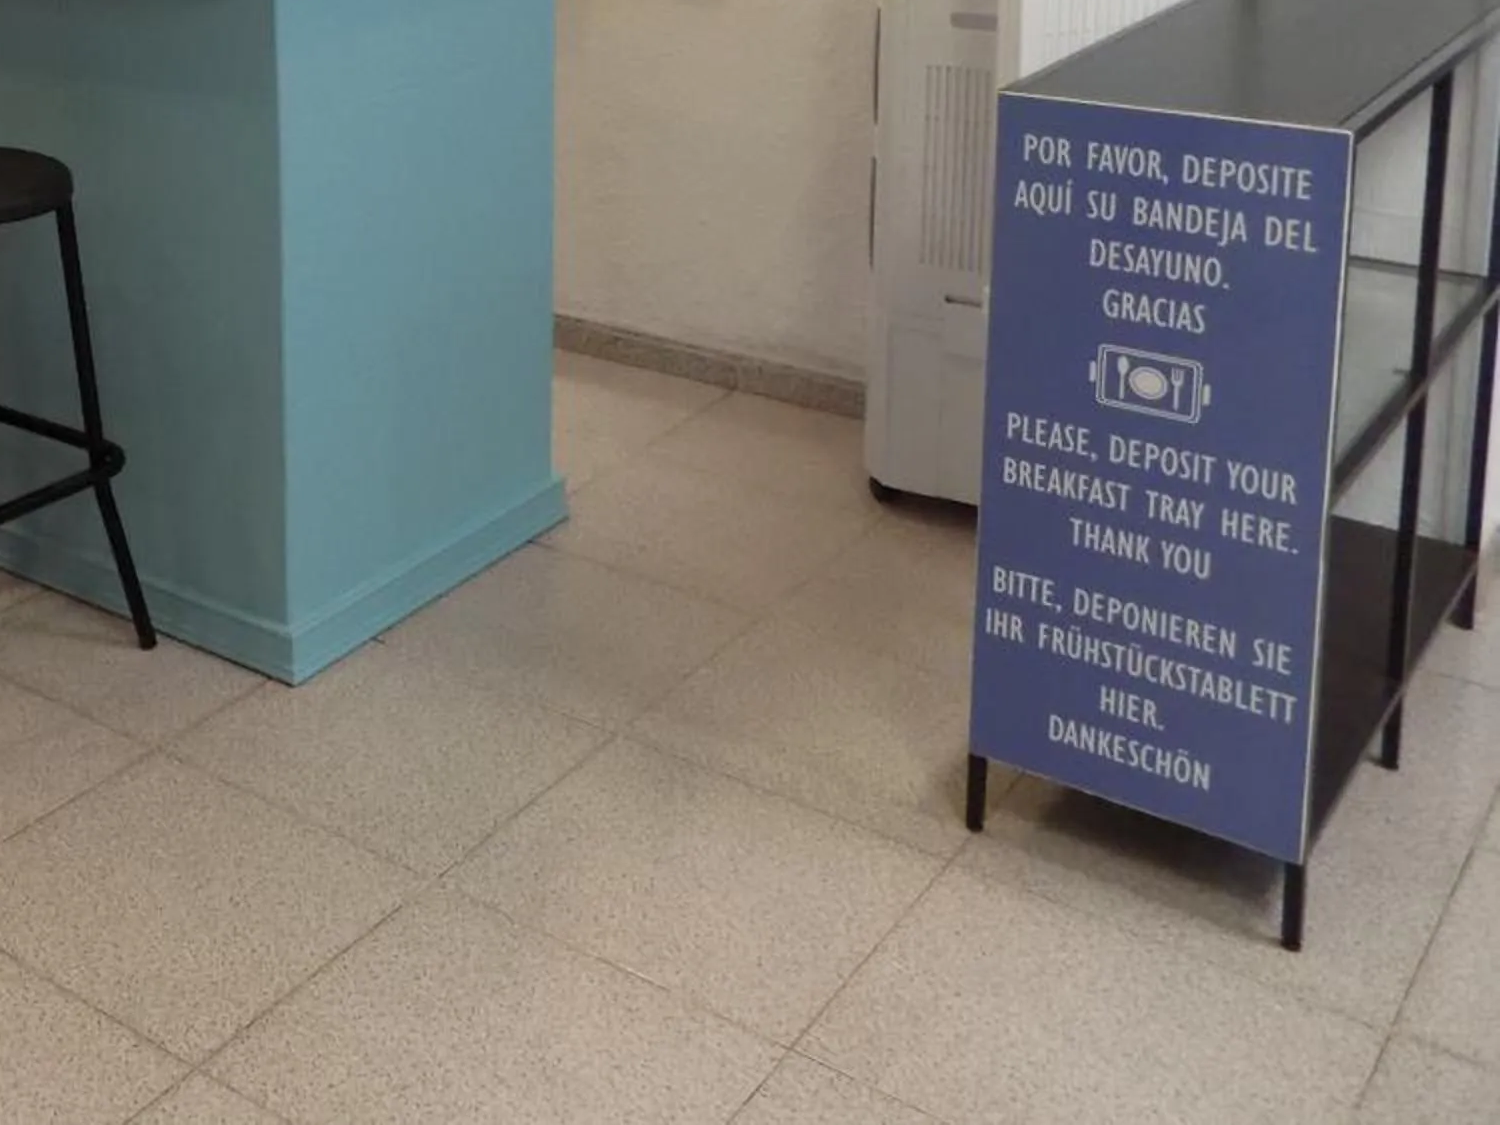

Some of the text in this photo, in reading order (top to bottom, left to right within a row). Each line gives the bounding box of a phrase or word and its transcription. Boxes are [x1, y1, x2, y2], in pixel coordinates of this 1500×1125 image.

[1023, 133, 1313, 200] POR FAVOR, DEPOSITE
[1014, 179, 1318, 253] AQUÍ SU BANDEJA DEL
[1089, 239, 1231, 290] DESAYUNO.
[1102, 289, 1206, 334] GRACIAS
[1007, 412, 1297, 506] PLEASE, DEPOSIT YOUR
[1003, 456, 1299, 555] BREAKFAST TRAY HERE.
[1069, 517, 1212, 579] THANK YOU
[992, 565, 1293, 675] BITTE, DEPONIEREN SIE
[986, 607, 1298, 725] IHR FRÜHSTÜCKSTABLETT
[1100, 686, 1166, 732] HIER.
[1048, 714, 1212, 791] DANKESCHÖN
